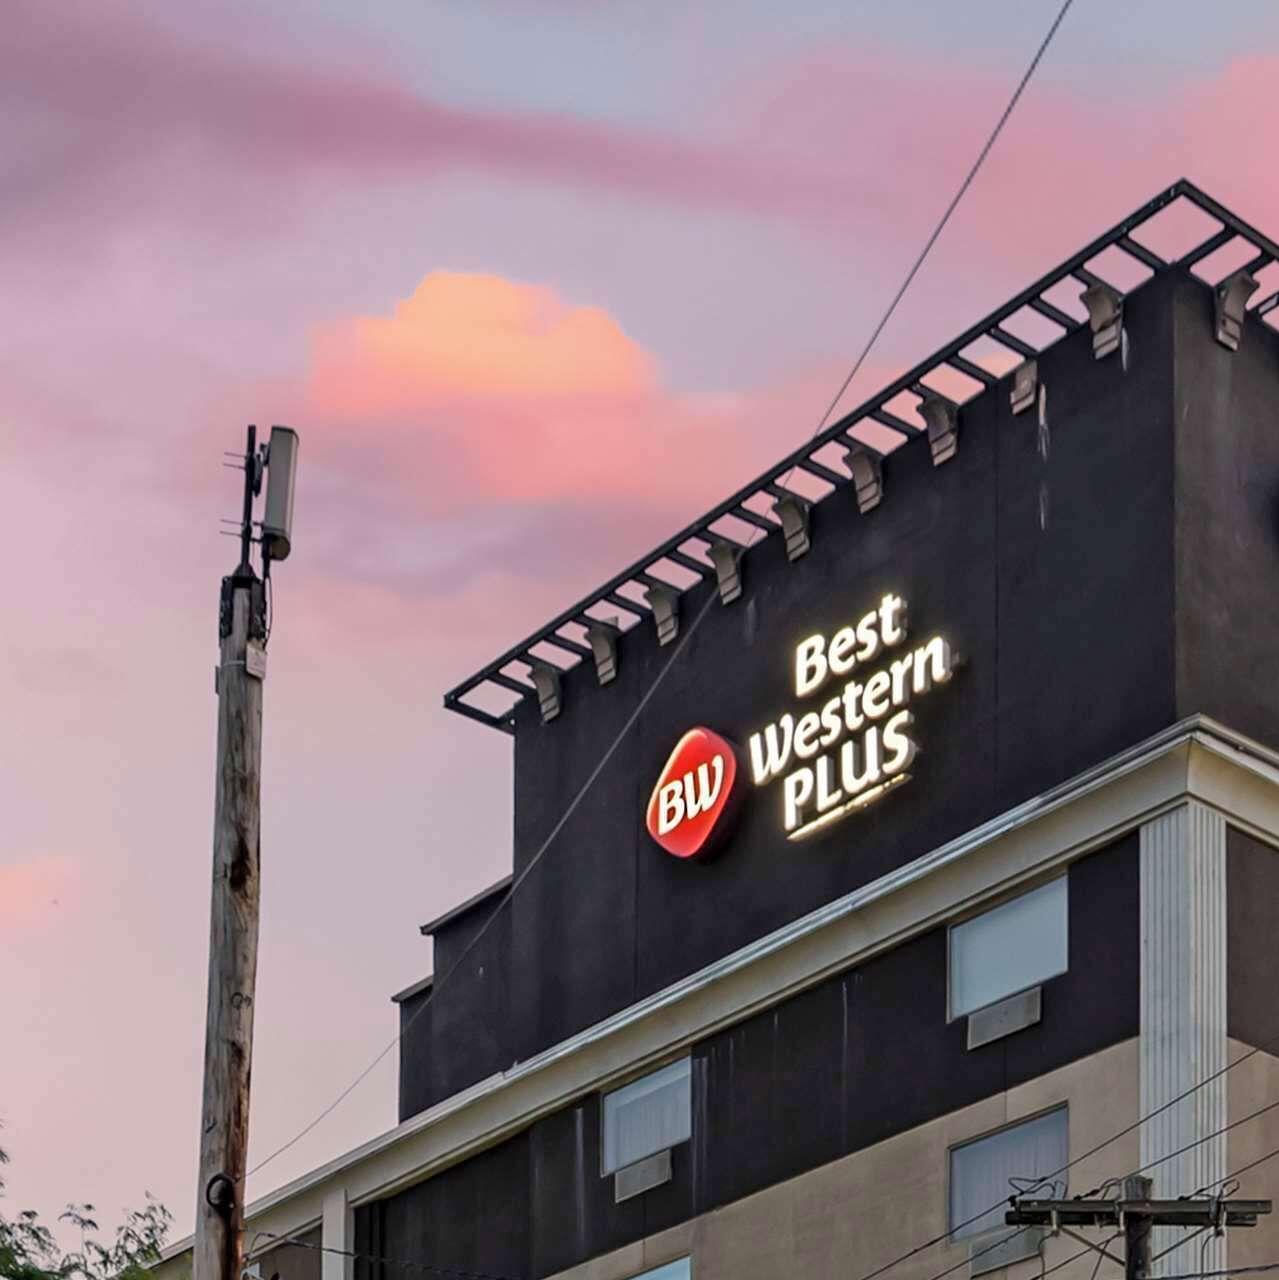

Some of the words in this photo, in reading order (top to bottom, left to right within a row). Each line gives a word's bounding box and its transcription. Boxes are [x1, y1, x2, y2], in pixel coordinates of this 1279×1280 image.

[795, 593, 904, 698] Best
[748, 635, 951, 786] Western
[658, 754, 724, 837] BW
[783, 708, 914, 831] PLUS
